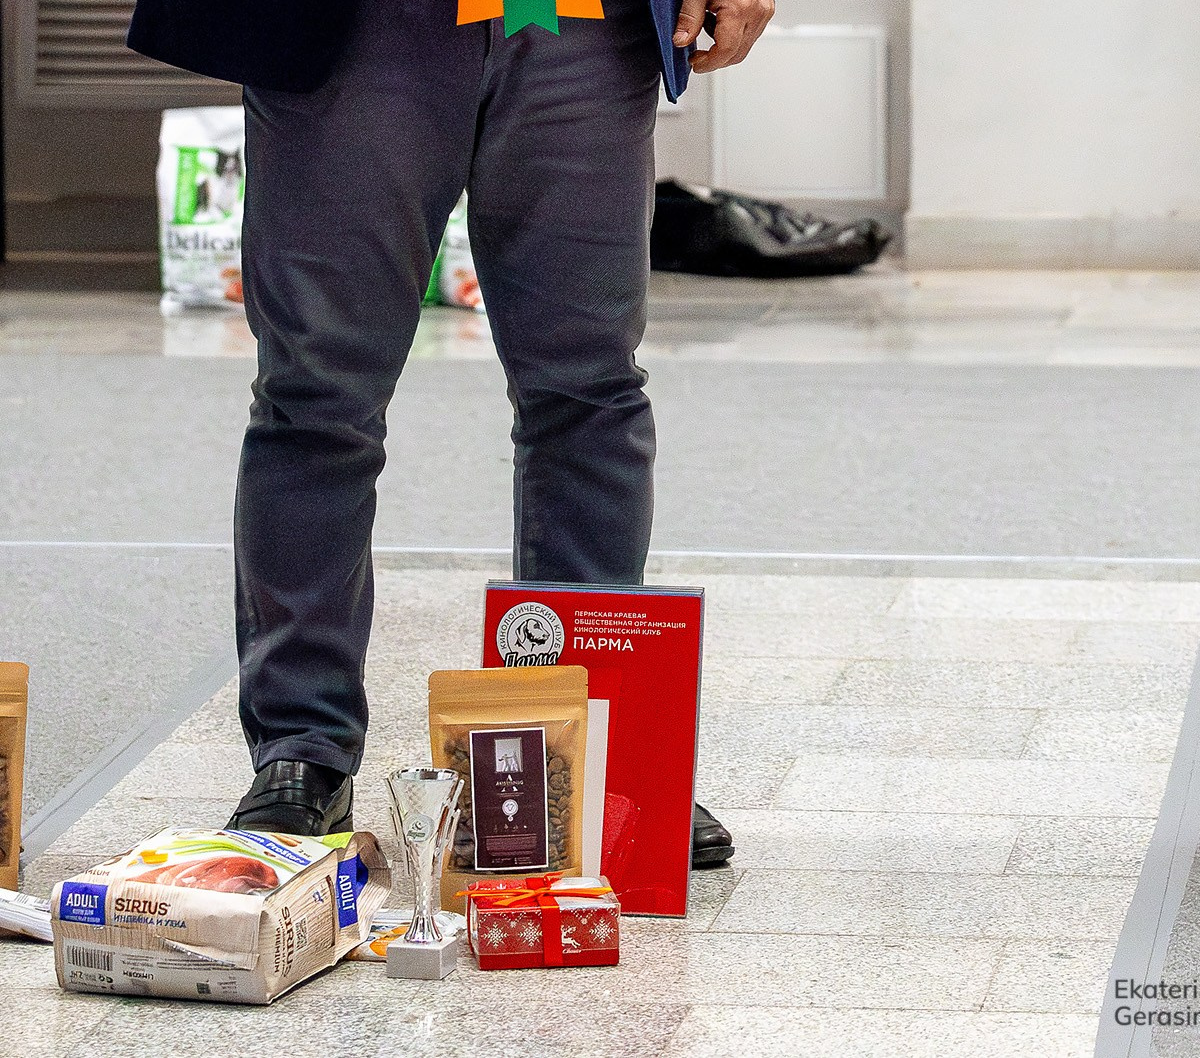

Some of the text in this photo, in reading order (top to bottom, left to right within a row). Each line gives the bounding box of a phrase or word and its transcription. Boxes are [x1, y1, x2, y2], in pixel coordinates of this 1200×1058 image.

[574, 610, 647, 619] ПЕРМСКАЯ КРАЕВАЯ
[499, 604, 562, 650] КИНОЛОГИЧЕСКИЙ КЛУБ
[574, 618, 686, 629] ОБЩЕСТВЕННАЯ ОРГАНИЗАЦИЯ
[574, 627, 662, 636] КИНОЛОГИЧЕСКИЙ КЛУБ
[573, 636, 634, 652] ПАРМА
[65, 892, 99, 909] ADULT
[338, 875, 356, 911] ADULT
[115, 898, 169, 916] SIRIUS
[281, 906, 295, 978] SIRIUS
